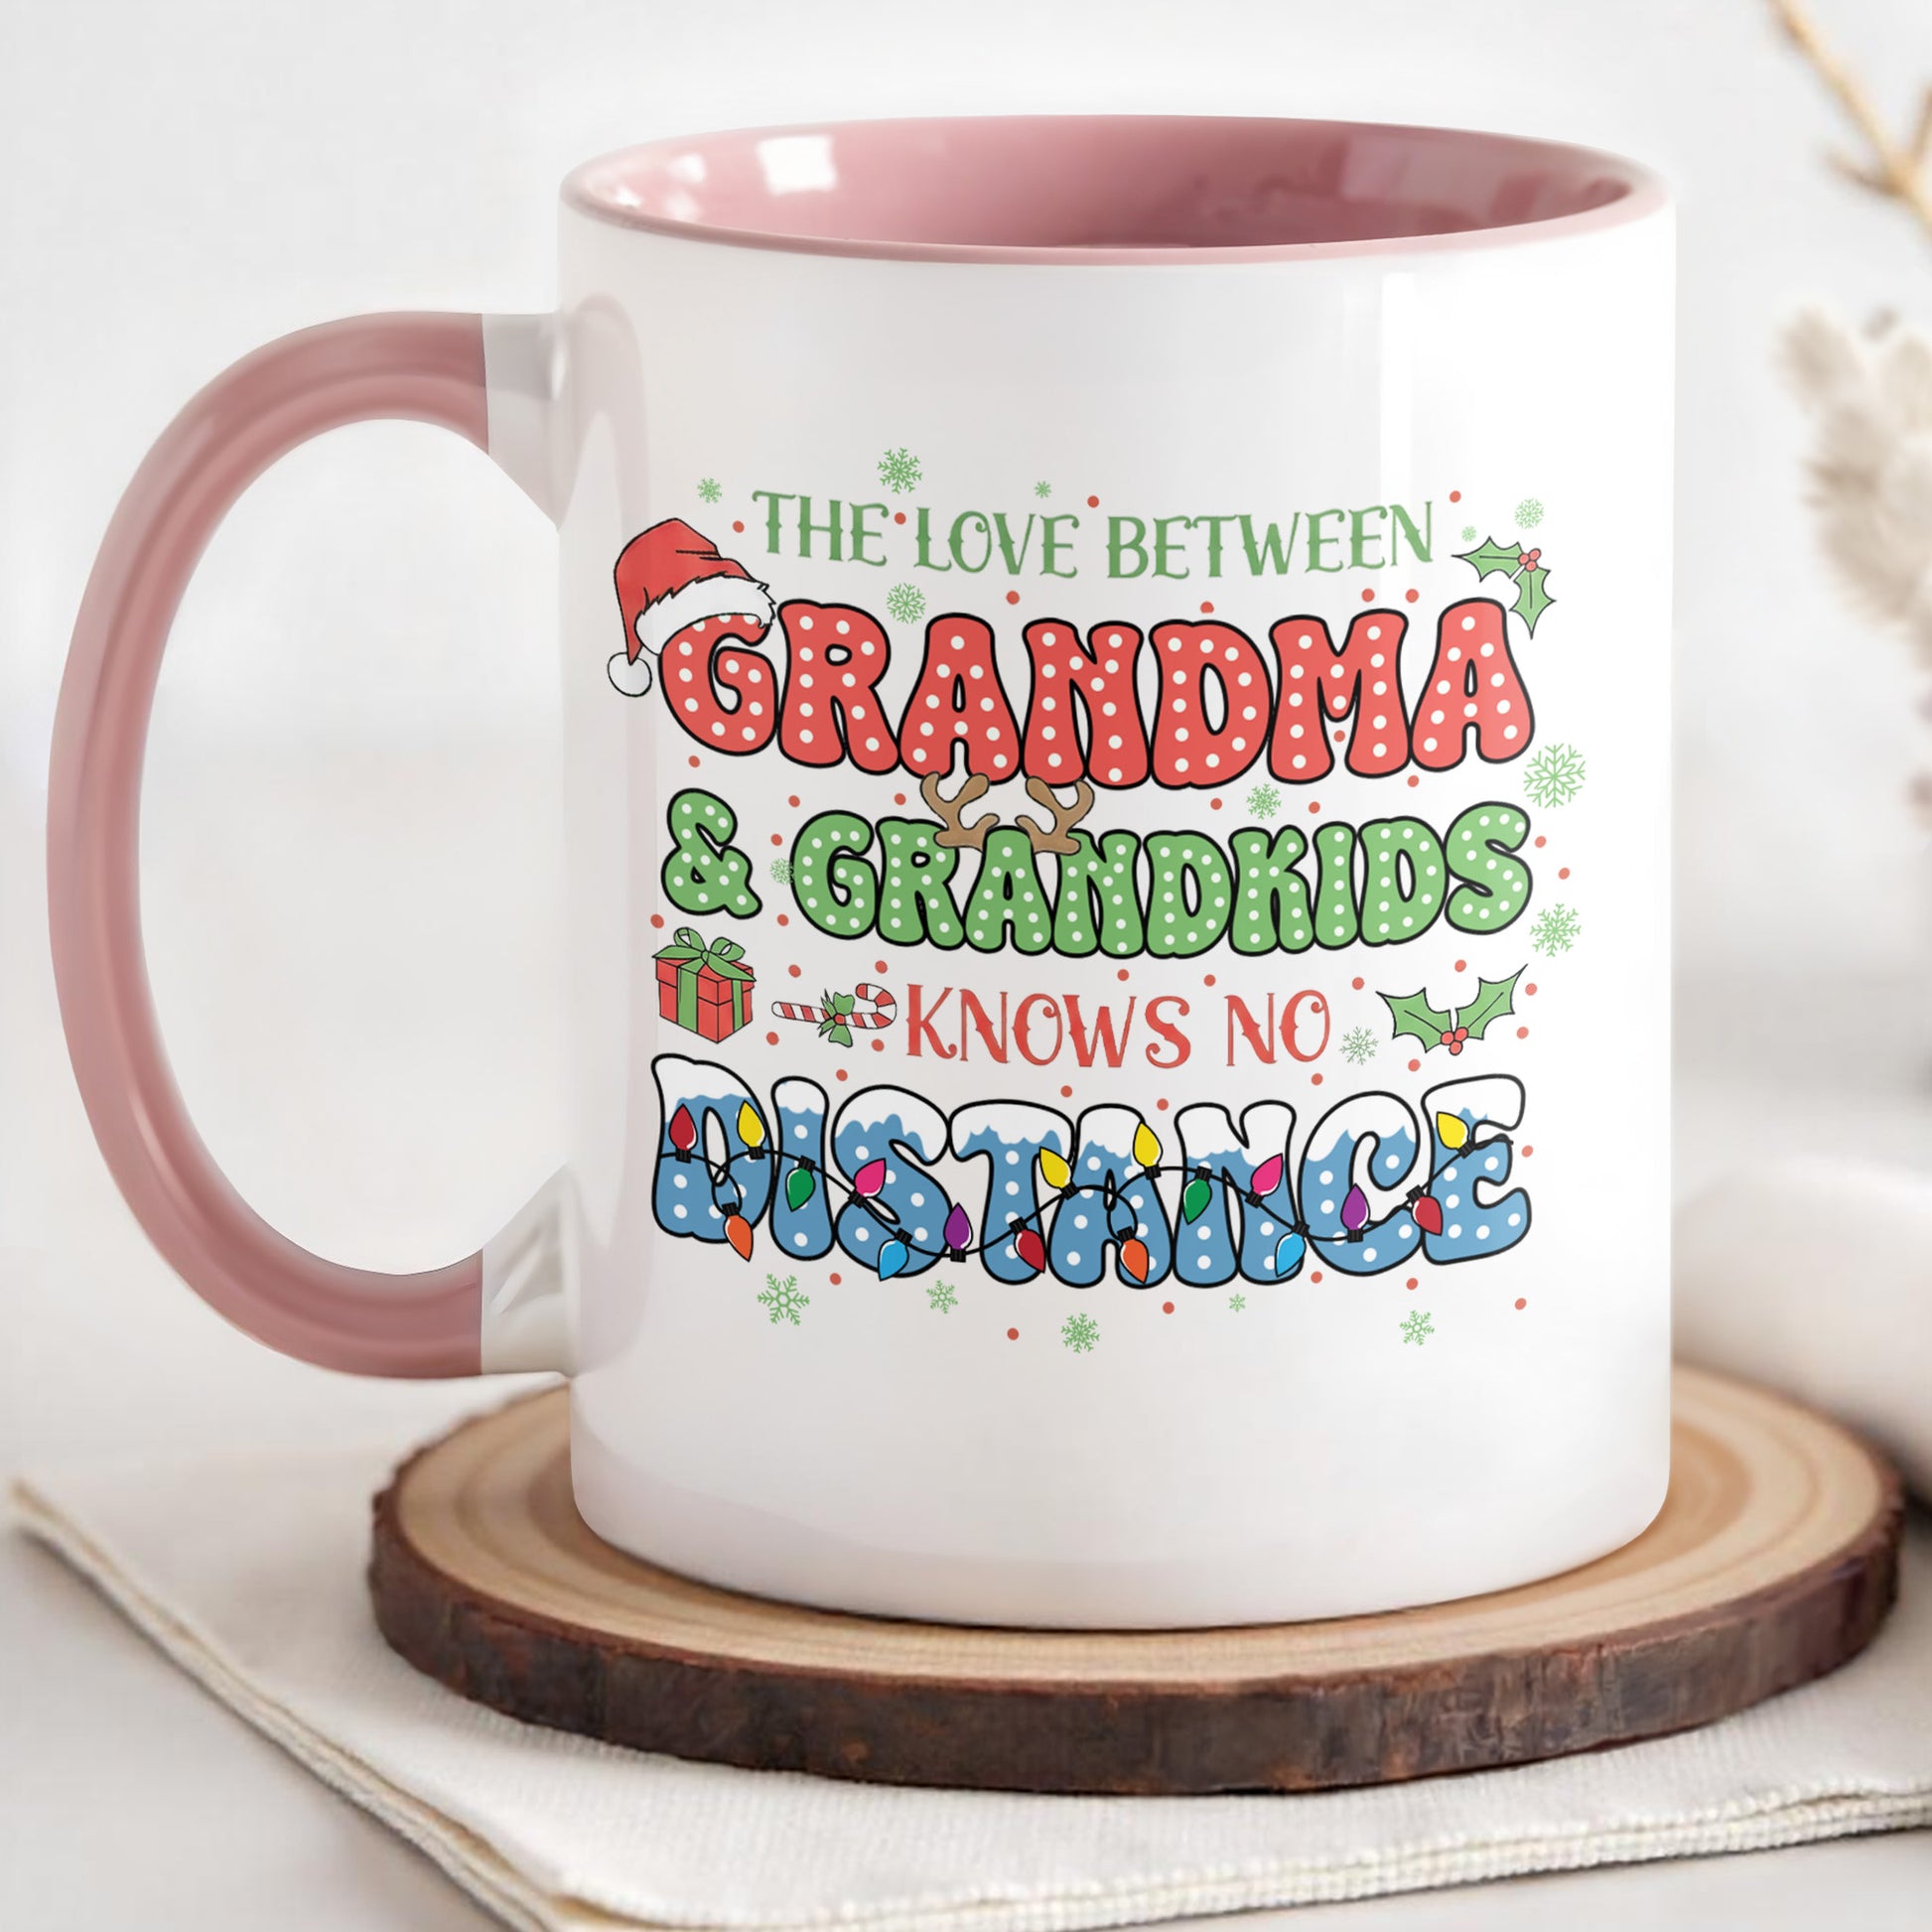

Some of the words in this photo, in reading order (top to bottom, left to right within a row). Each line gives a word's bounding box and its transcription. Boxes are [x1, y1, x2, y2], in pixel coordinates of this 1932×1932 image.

[753, 491, 889, 563] THE
[914, 507, 1079, 577] LOVE
[1108, 501, 1434, 579] BETWEEN
[658, 598, 1535, 788] GRANDMA
[661, 789, 760, 917] &
[792, 802, 1533, 957] GRANDKIDS
[905, 984, 1191, 1068] KNOWS
[1226, 989, 1330, 1067] NO
[651, 1054, 1531, 1288] DISTANCE
